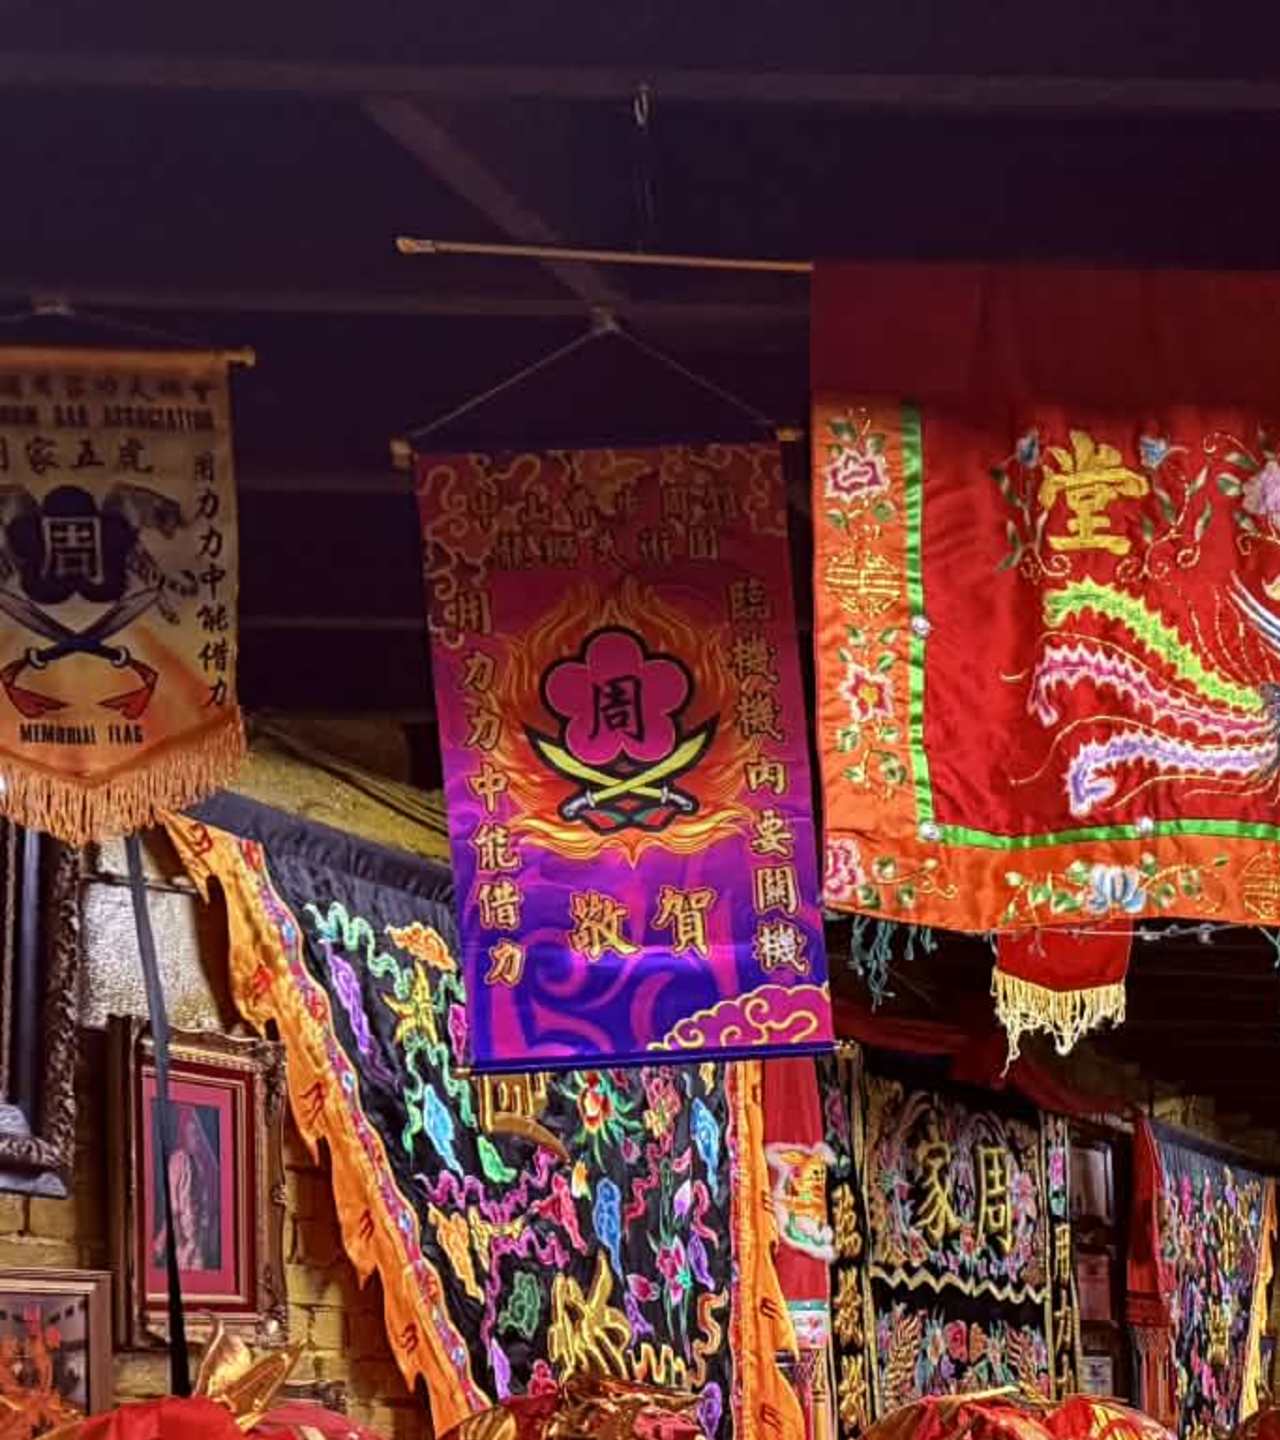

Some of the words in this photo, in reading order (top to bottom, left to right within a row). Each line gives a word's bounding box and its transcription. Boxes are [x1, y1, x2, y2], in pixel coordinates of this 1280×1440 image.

[0, 436, 154, 475] 家五虎
[41, 516, 101, 584] 周
[589, 674, 645, 743] 周
[568, 887, 717, 961] 敬賀
